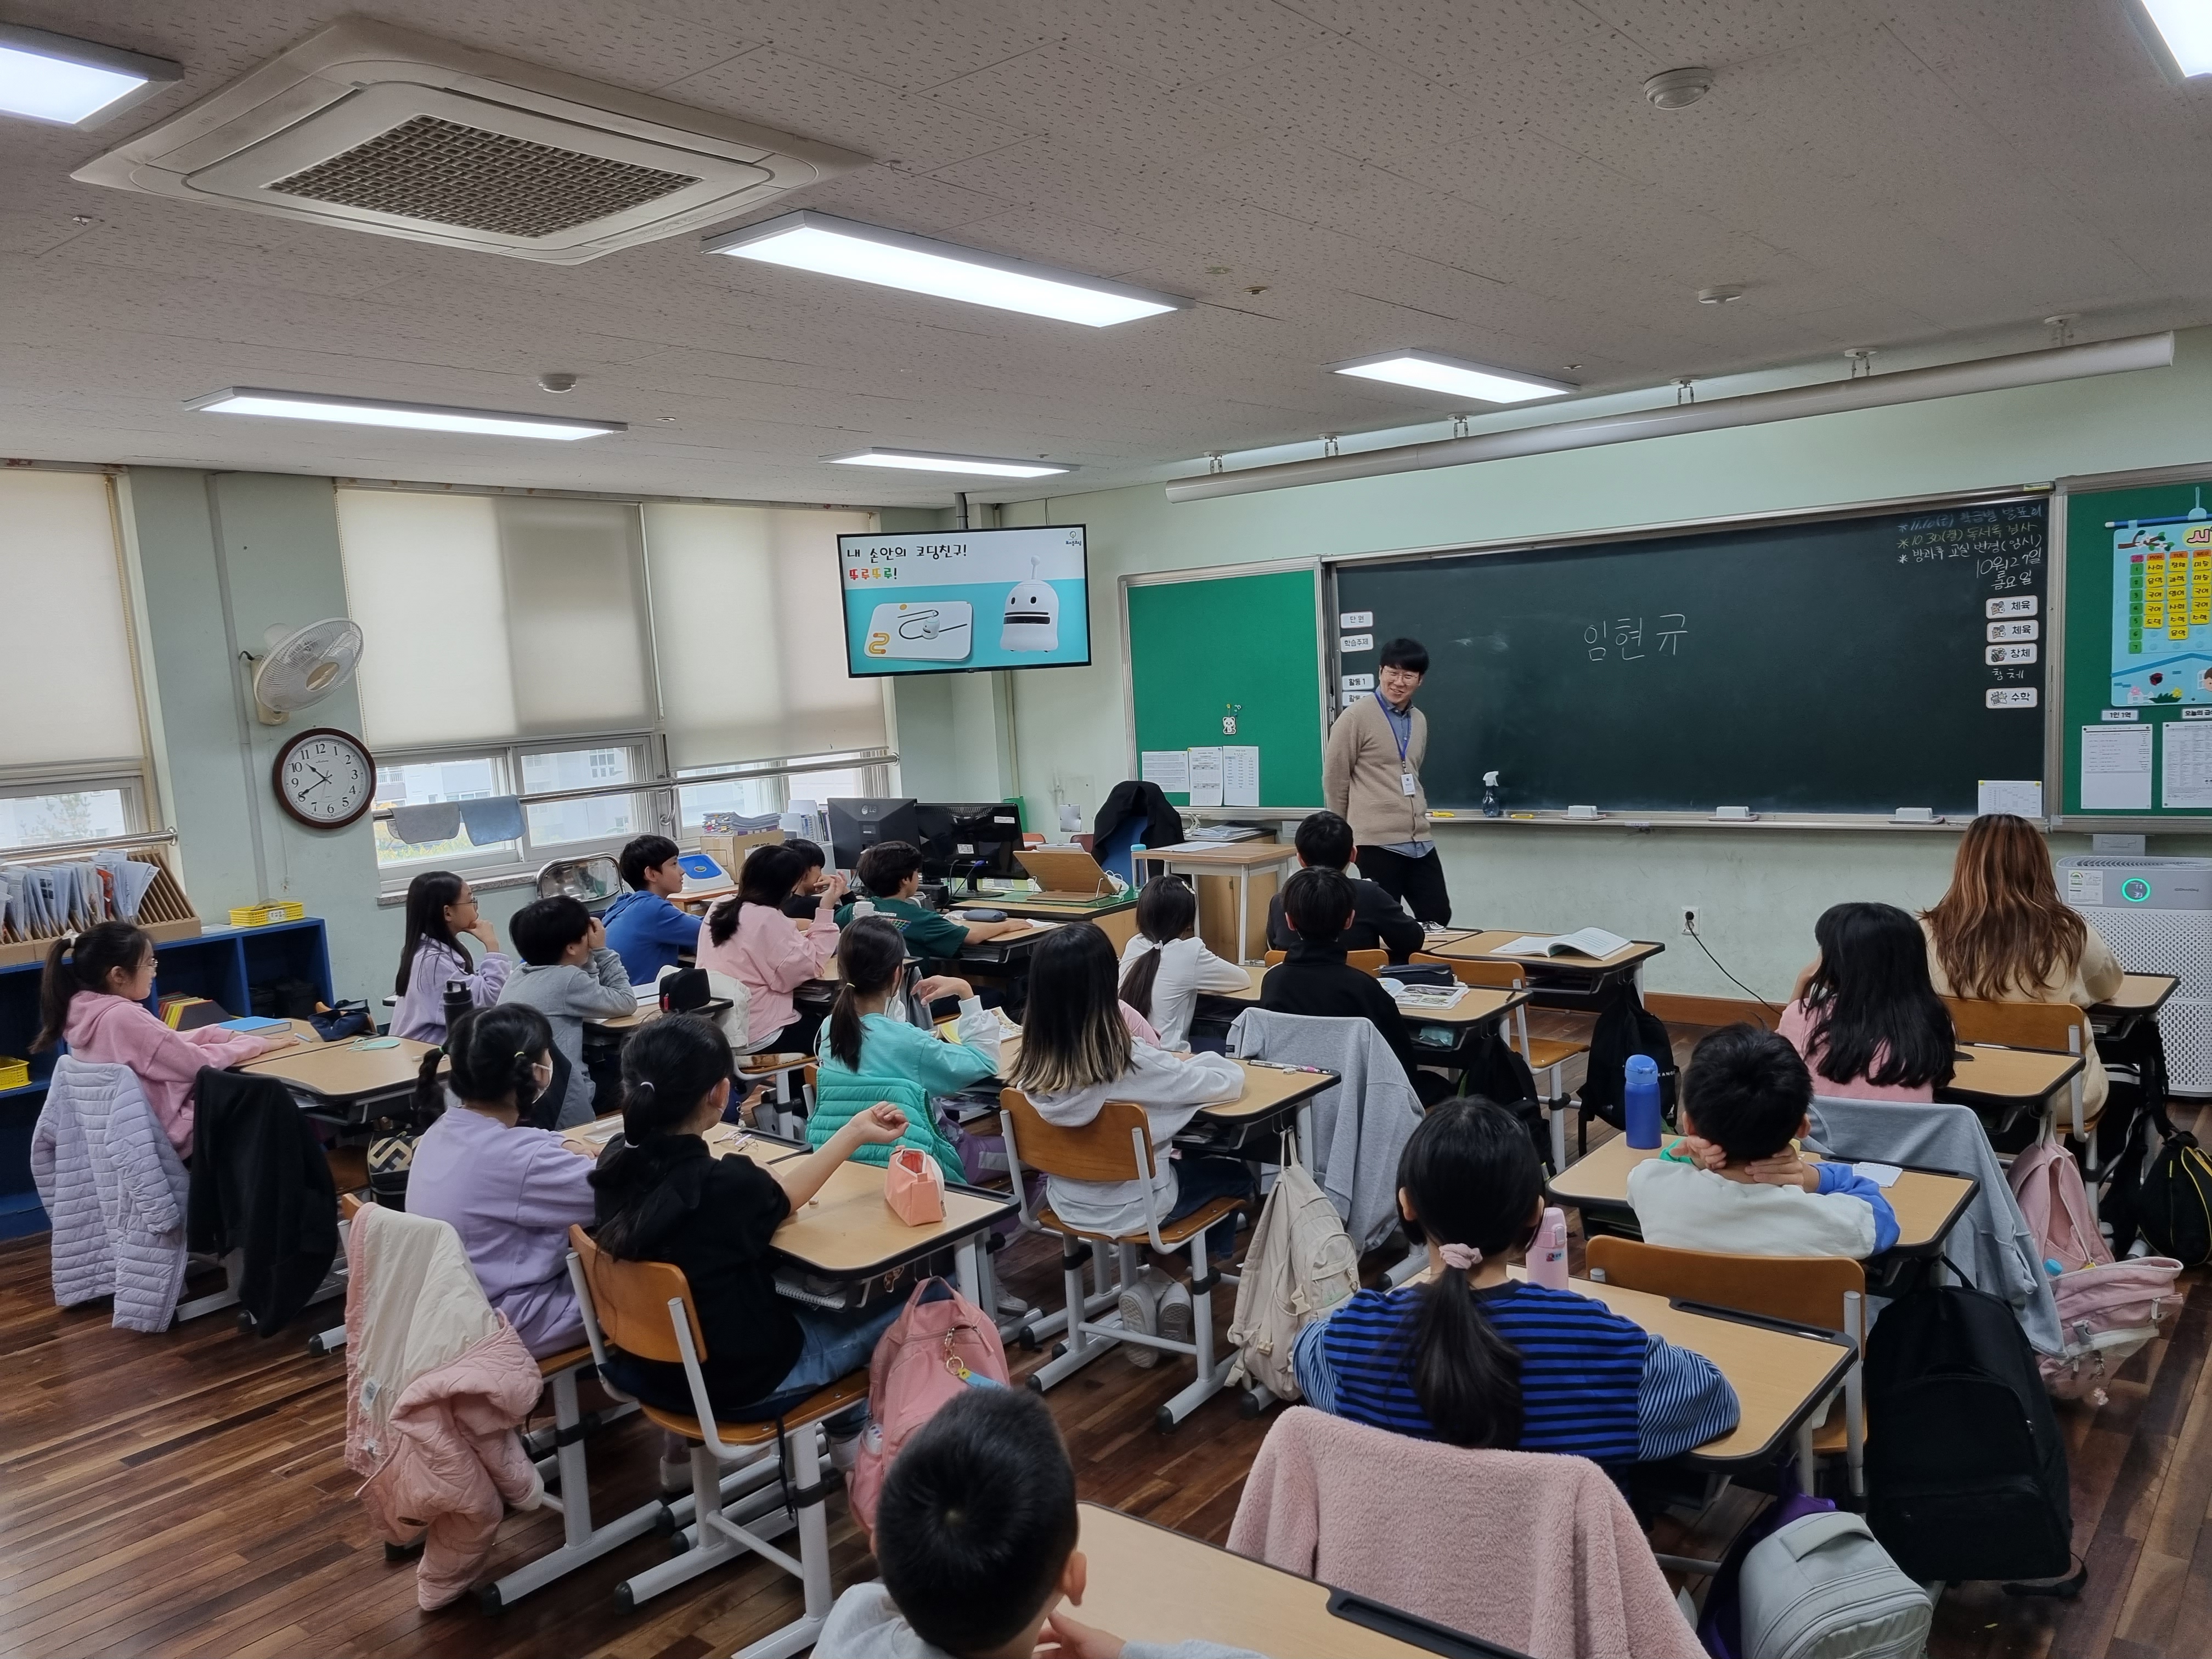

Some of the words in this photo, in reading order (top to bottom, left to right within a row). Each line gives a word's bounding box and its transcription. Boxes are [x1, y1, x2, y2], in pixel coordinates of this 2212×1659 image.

[1967, 524, 2001, 538] 독서록
[2008, 522, 2038, 535] 검사
[847, 548, 861, 558] 내
[870, 547, 907, 564] 손안의
[916, 544, 967, 560] 코딩친구!
[1912, 546, 1944, 562] 방과후
[1948, 543, 1971, 557] 교실
[849, 567, 897, 580] 뚜루뚜루!
[2011, 600, 2030, 611] 체육
[2012, 625, 2032, 635] 체육
[1345, 638, 1368, 647] 학습주제
[1584, 614, 1688, 661] 임현규
[2011, 648, 2030, 658] 창체
[2011, 692, 2030, 702] 수학
[315, 743, 326, 754] 12
[334, 746, 338, 756] 1
[301, 749, 309, 760] 11
[345, 754, 352, 765] 2
[291, 761, 302, 773] 10
[351, 770, 358, 780] 3
[291, 778, 299, 788] 9
[349, 785, 356, 795] 4
[298, 791, 306, 802] 8
[342, 797, 349, 807] 5
[311, 802, 317, 812] 7
[327, 803, 334, 814] 6
